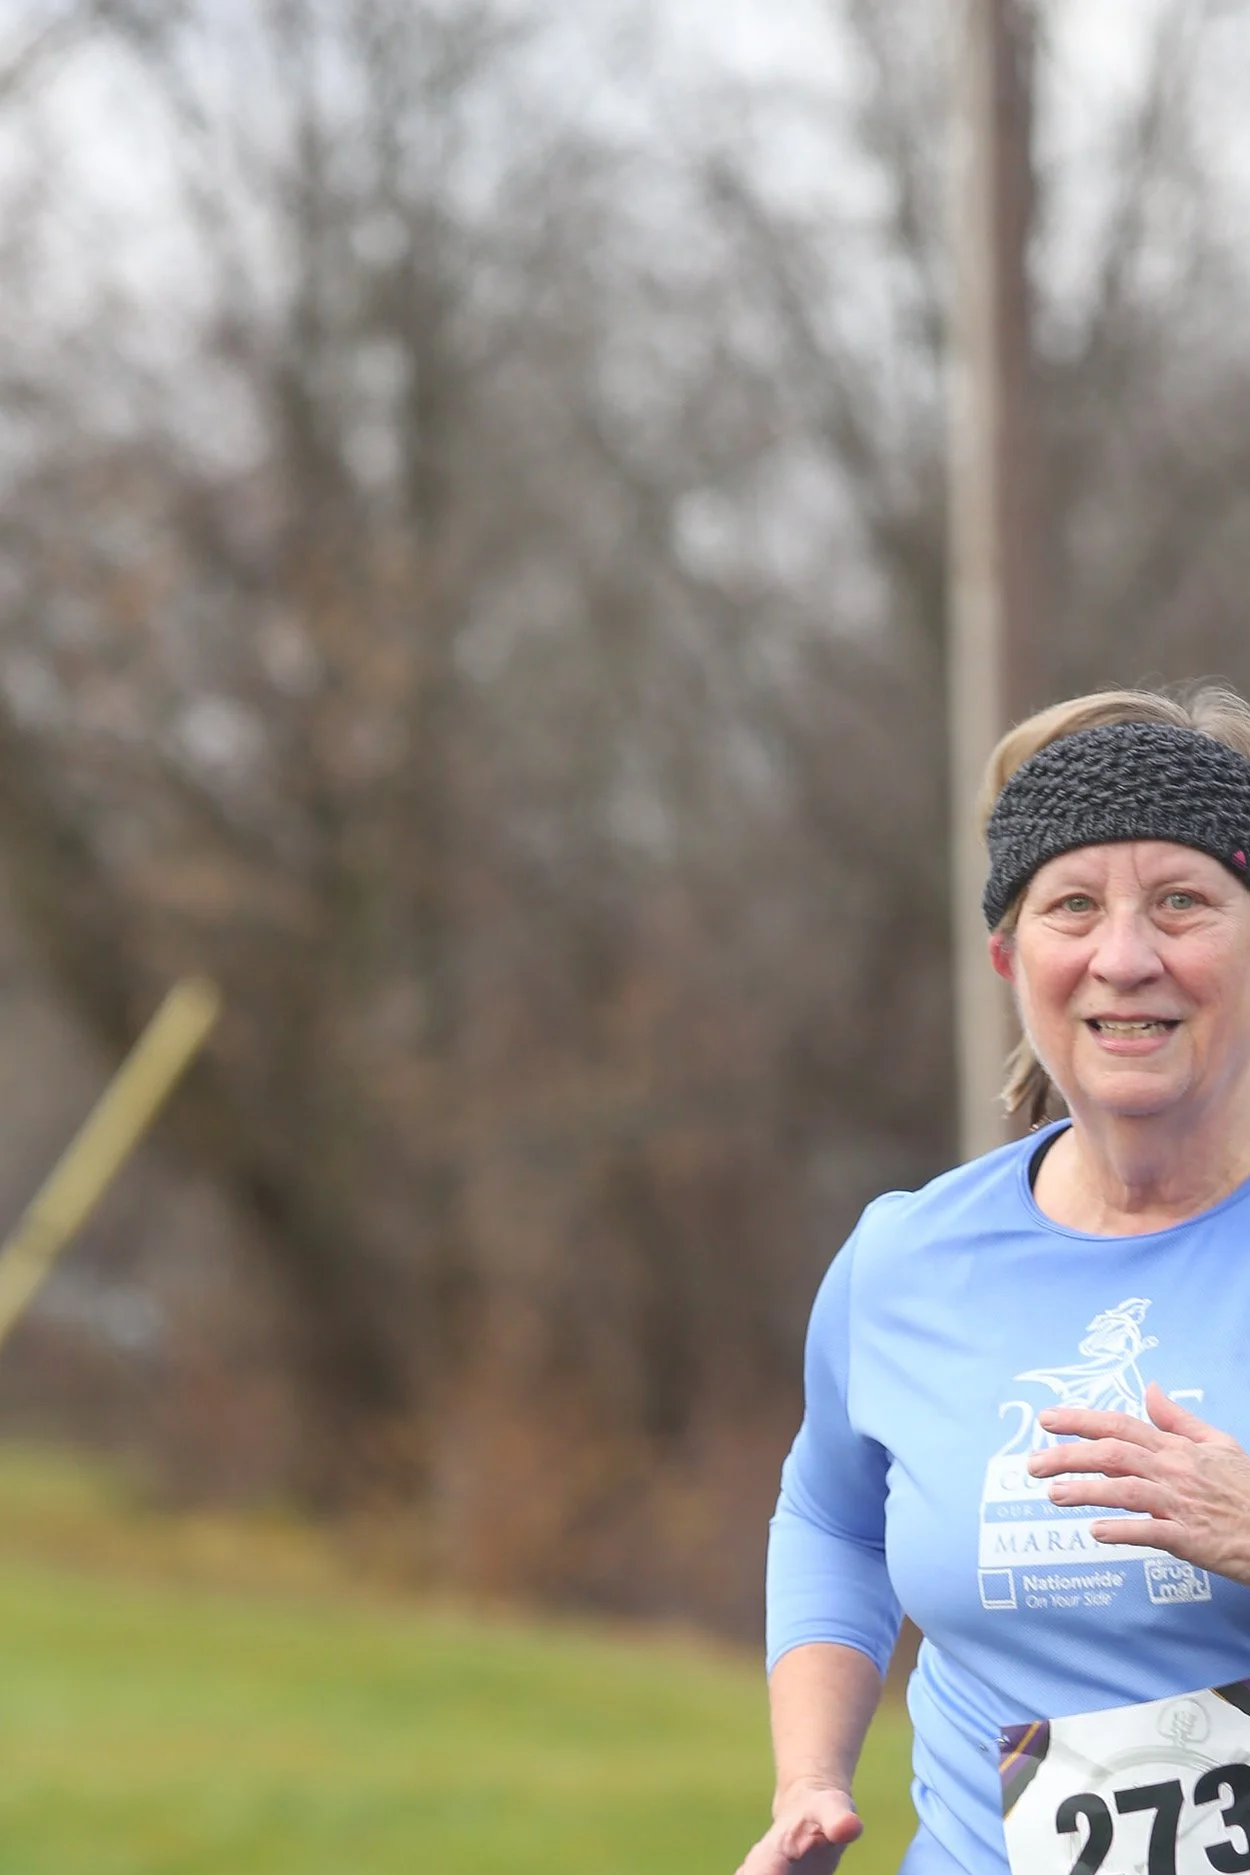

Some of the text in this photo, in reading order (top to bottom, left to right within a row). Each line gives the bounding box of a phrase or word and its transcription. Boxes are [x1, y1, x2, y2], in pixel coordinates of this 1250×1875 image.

[995, 1529, 1087, 1553] MARA
[1022, 1571, 1124, 1592] Nationwide
[1025, 1591, 1113, 1609] On Your Side
